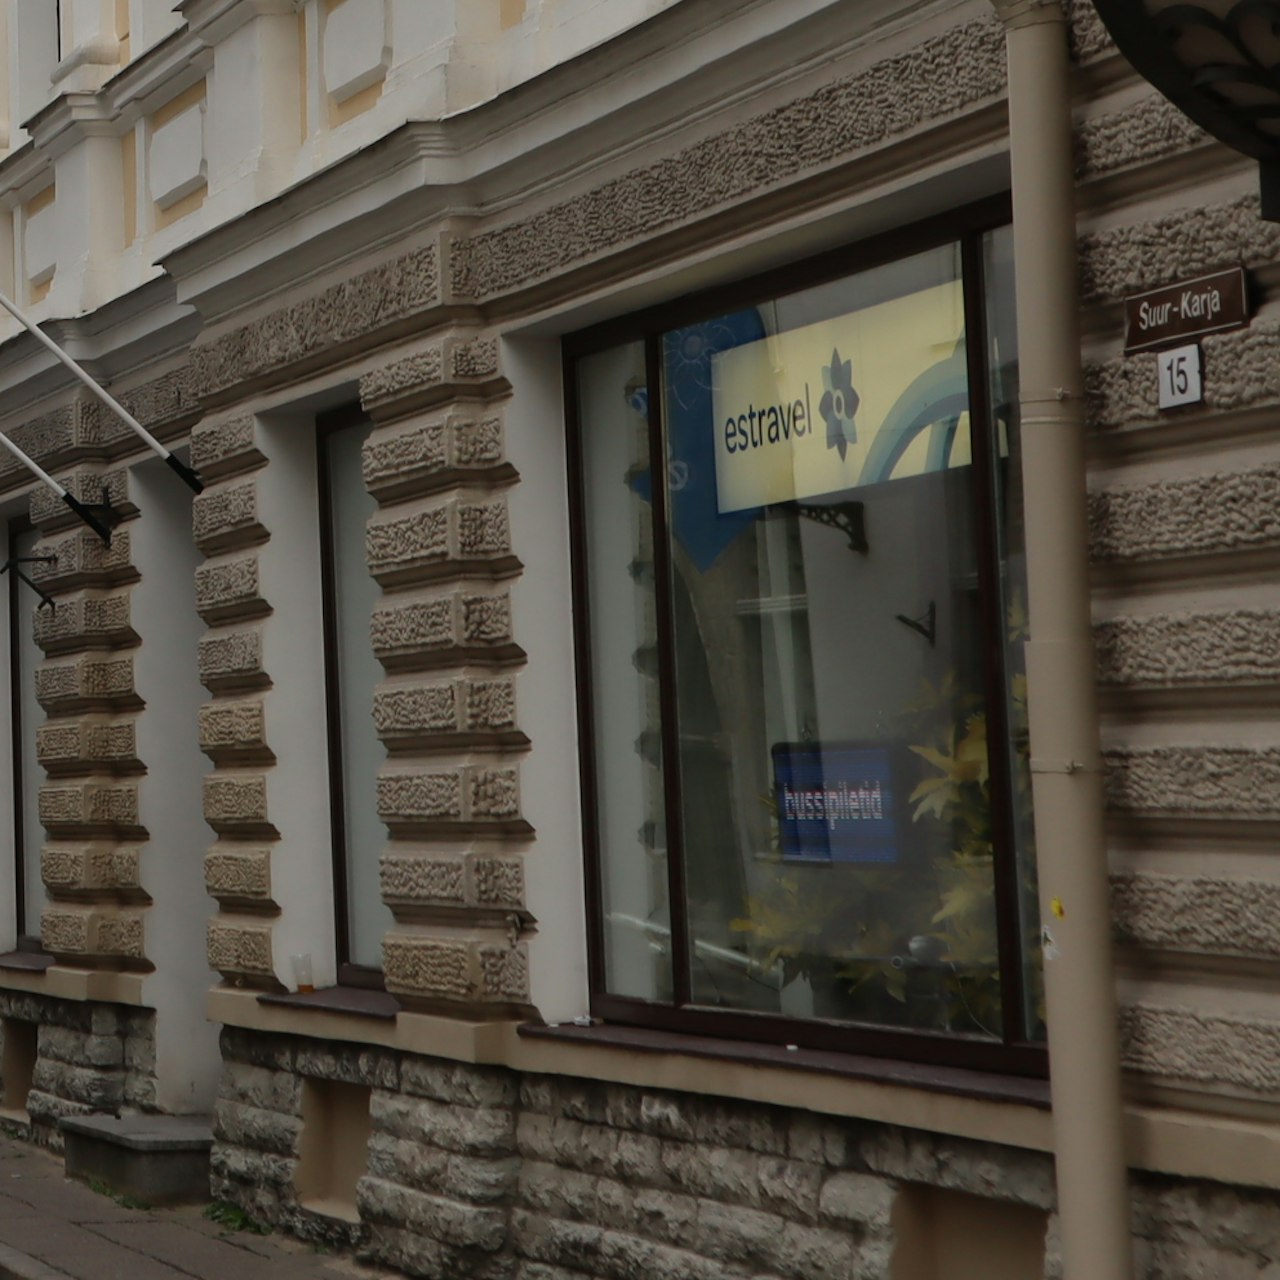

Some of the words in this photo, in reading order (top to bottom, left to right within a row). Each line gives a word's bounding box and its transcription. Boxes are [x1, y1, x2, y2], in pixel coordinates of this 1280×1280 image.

[1139, 285, 1221, 331] Suur-Karja
[1166, 356, 1188, 396] 15
[724, 382, 812, 454] estravel
[784, 780, 883, 831] bussipiletid
